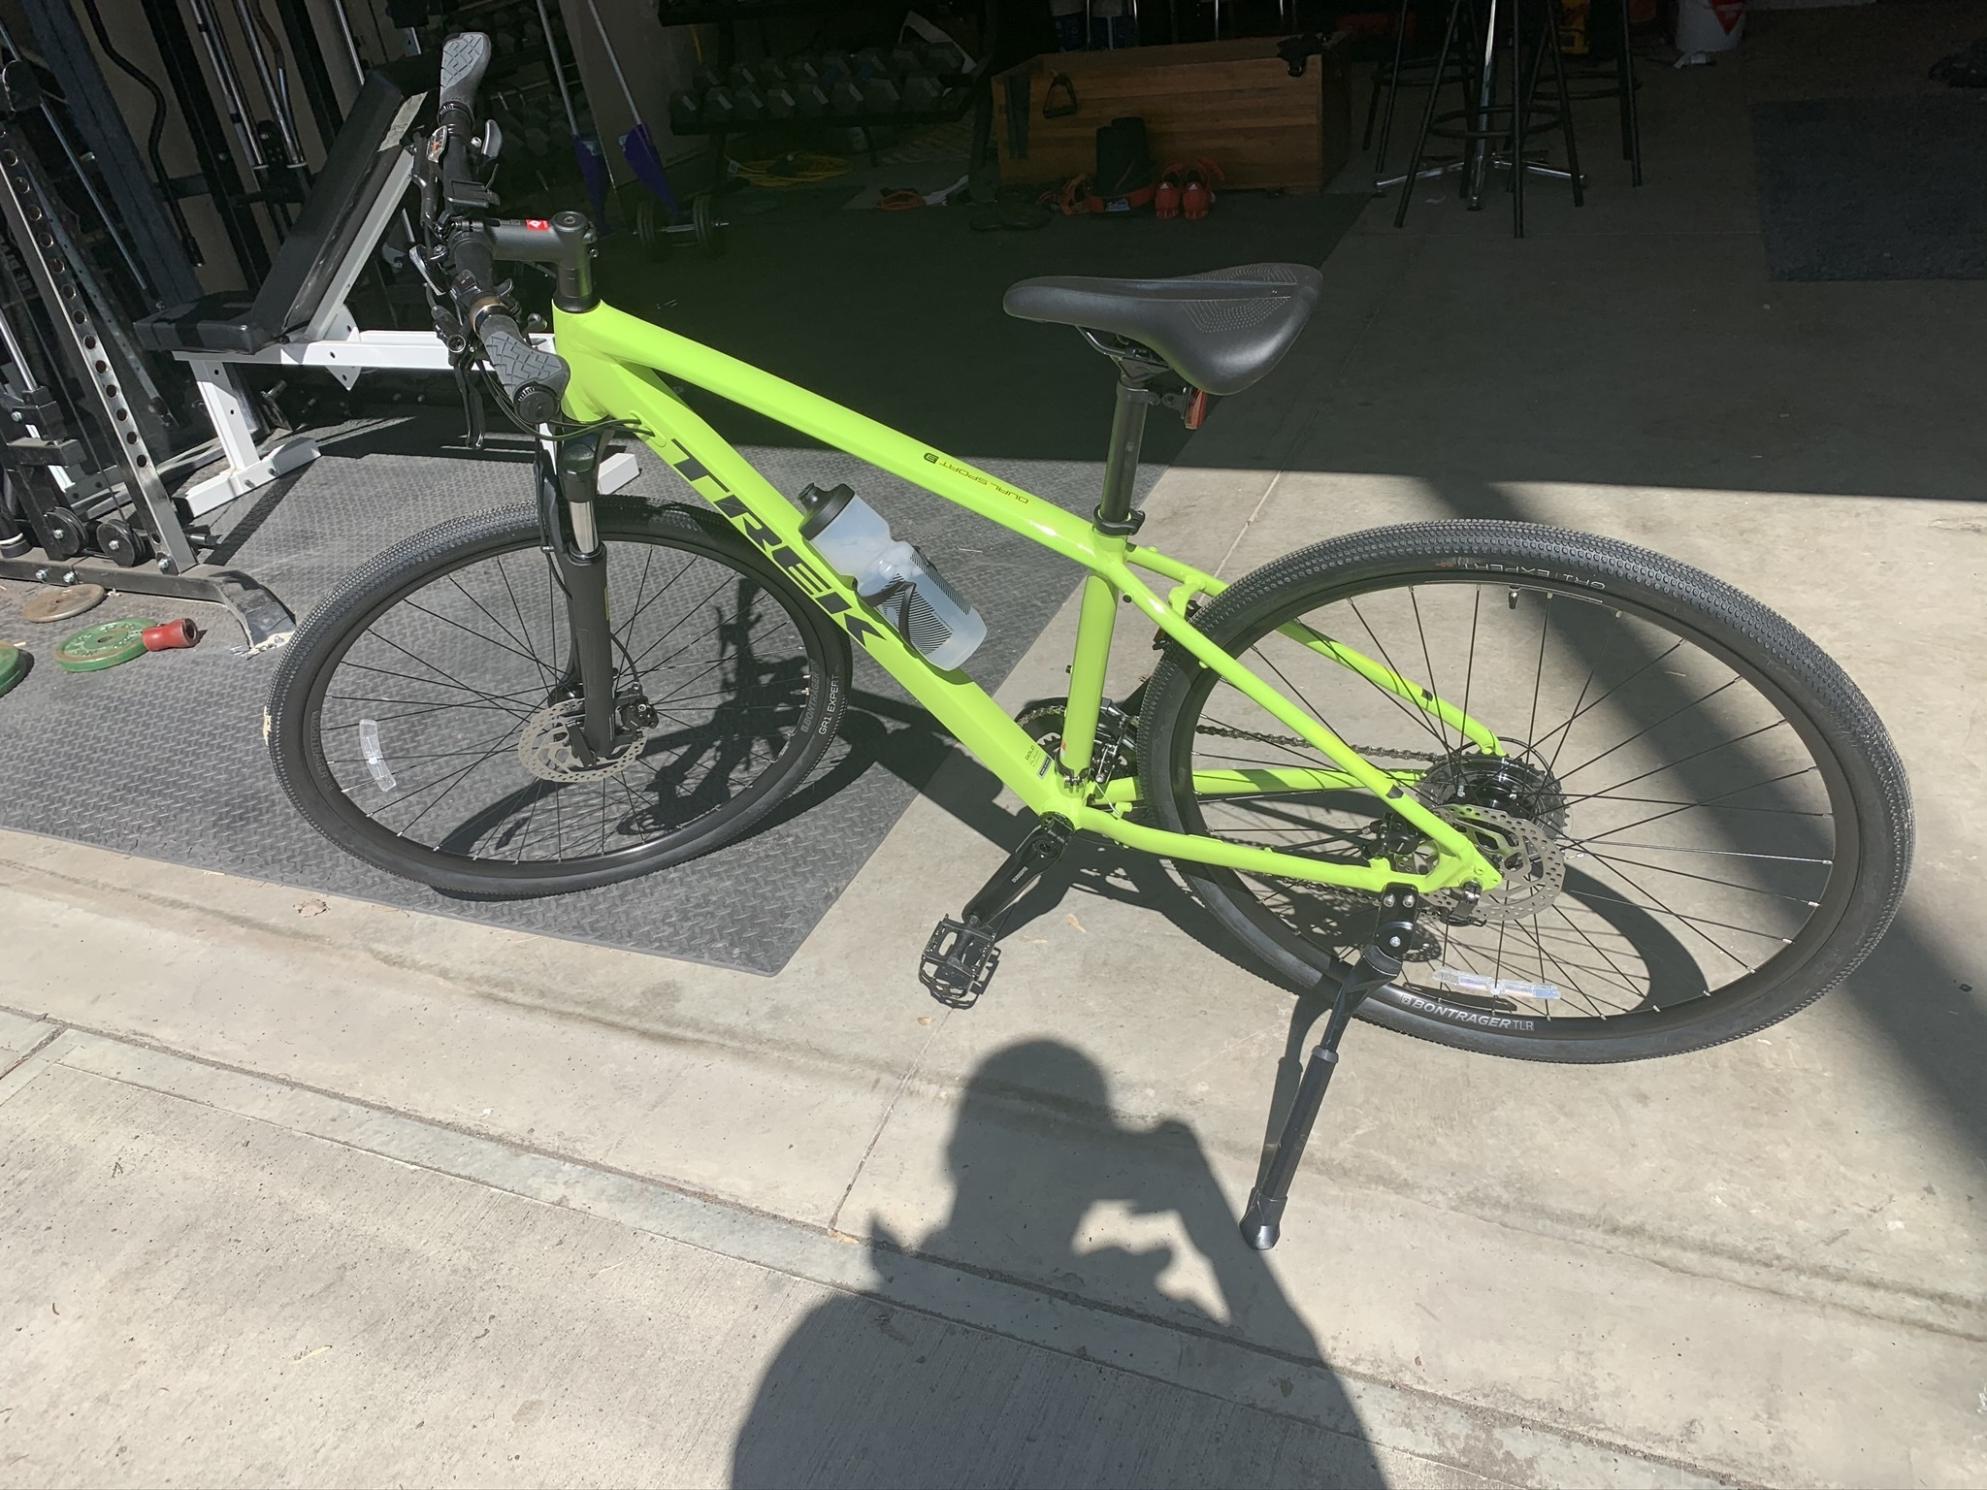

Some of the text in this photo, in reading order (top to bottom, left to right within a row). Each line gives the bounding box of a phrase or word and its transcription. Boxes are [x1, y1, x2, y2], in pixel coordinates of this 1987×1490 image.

[938, 460, 988, 486] SPORT
[990, 482, 1029, 504] DUAL
[671, 438, 887, 646] TREK
[818, 674, 840, 735] GR1 EXPERT
[1411, 999, 1534, 1031] BONTRAGER TLR
